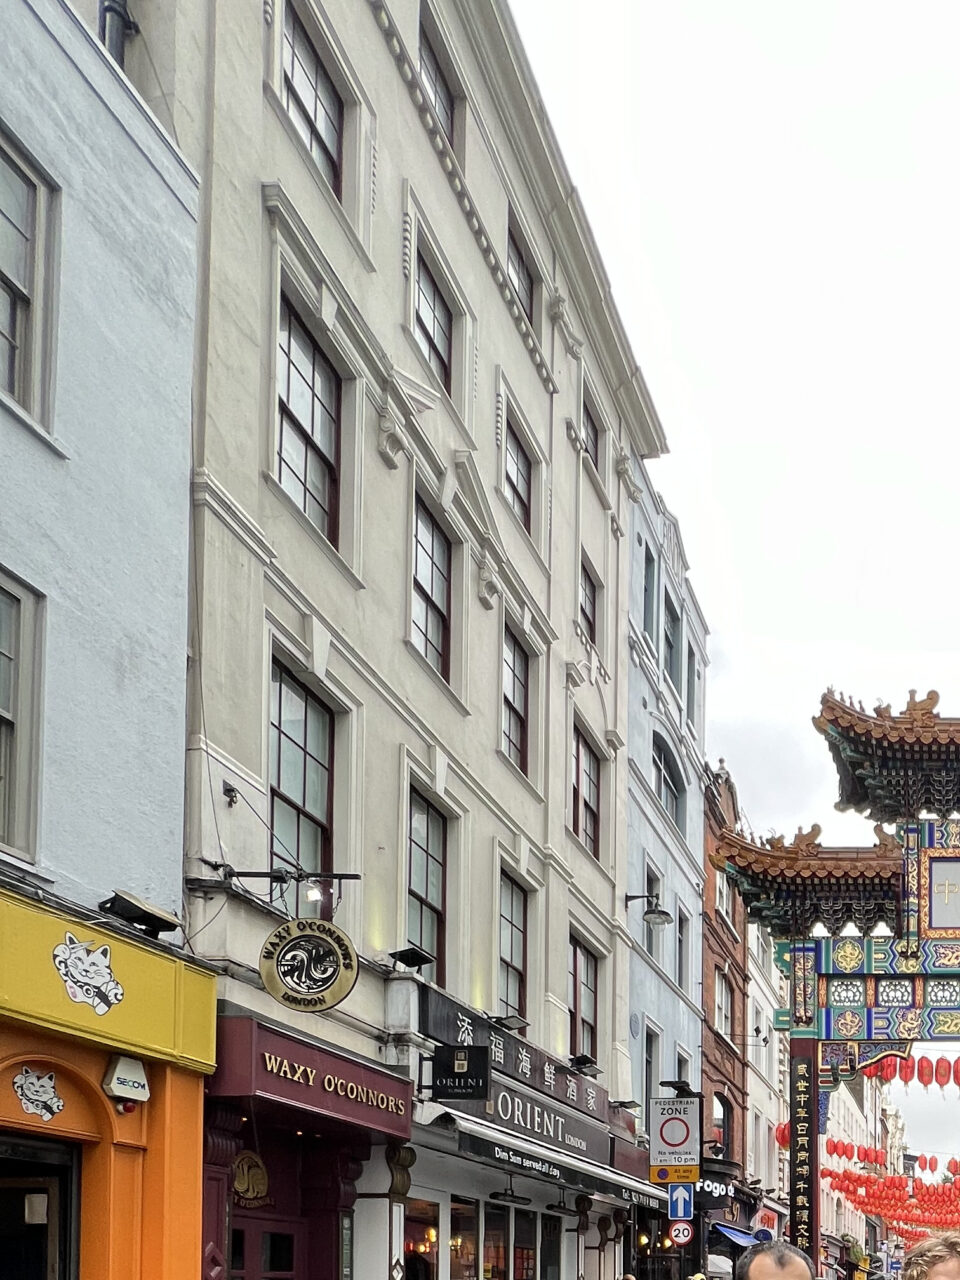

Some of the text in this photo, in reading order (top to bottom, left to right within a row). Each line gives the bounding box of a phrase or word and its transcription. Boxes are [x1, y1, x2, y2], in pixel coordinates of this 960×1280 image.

[263, 925, 291, 960] WAXY
[281, 991, 327, 1007] LONDON
[116, 1076, 146, 1091] SECOM
[264, 1052, 405, 1115] WAXY O'CONNOR'S
[660, 1107, 689, 1116] ZONE
[498, 1092, 587, 1150] ORIENT LONDON
[495, 1146, 560, 1178] Dim Sum served all day
[695, 1180, 726, 1197] Fogo
[673, 1228, 690, 1238] 20
